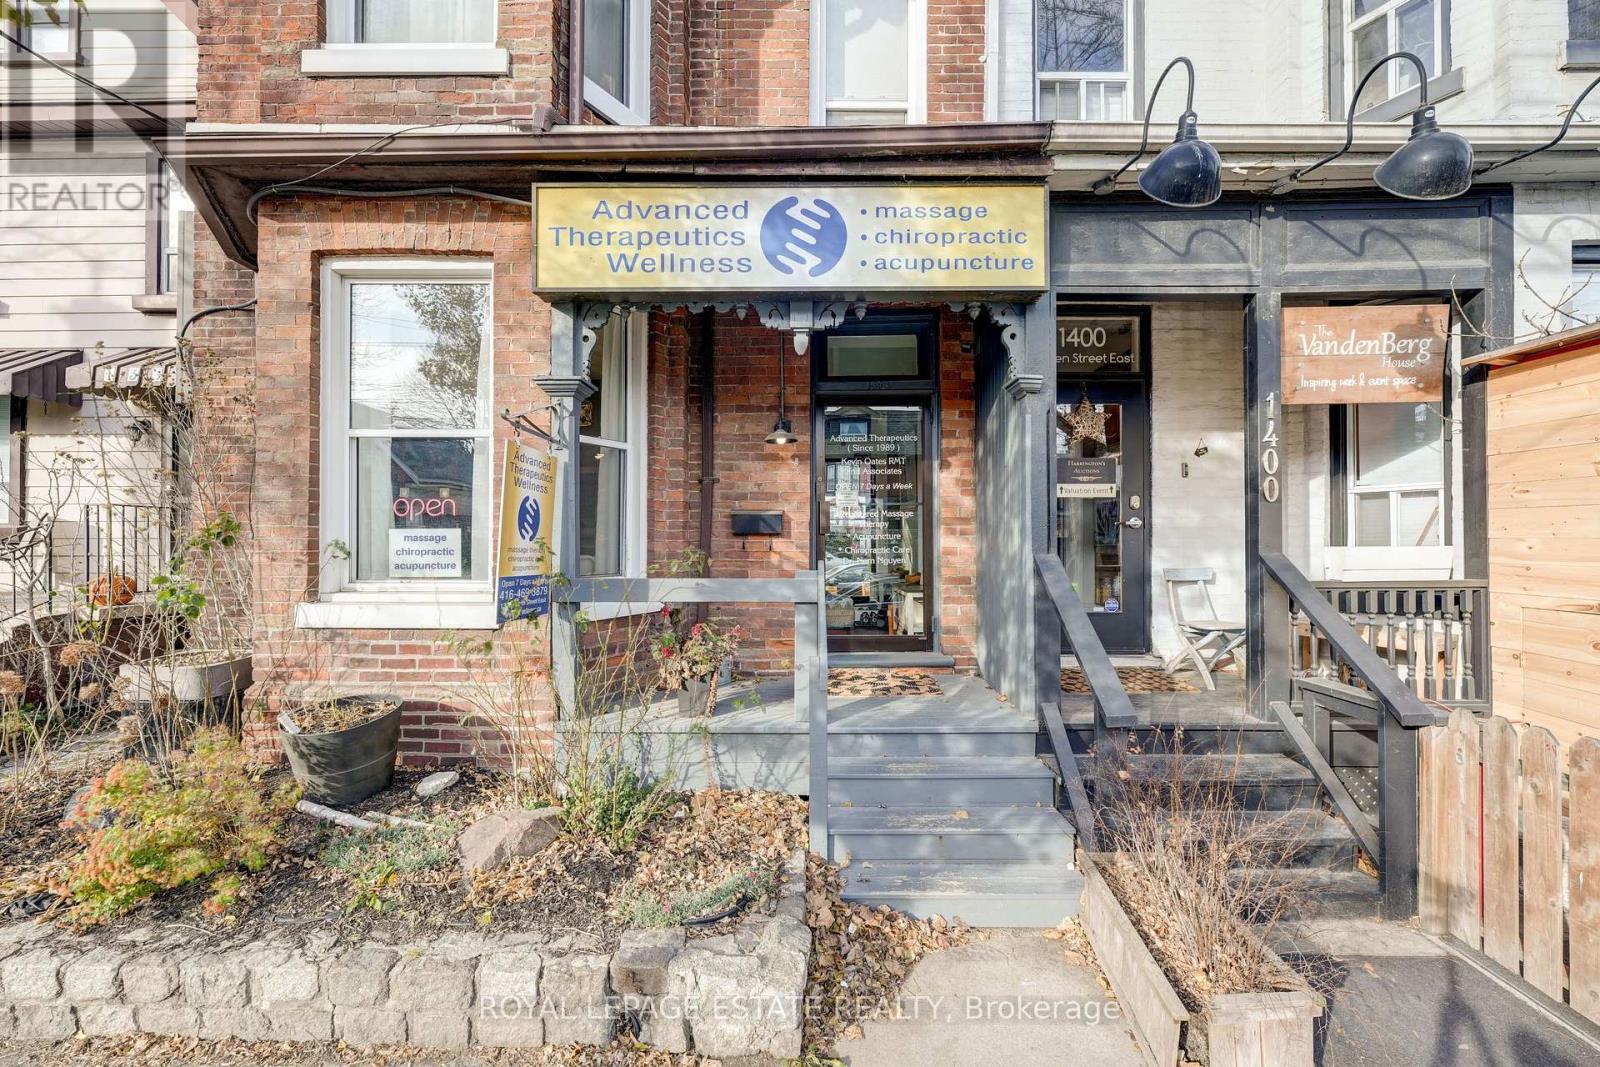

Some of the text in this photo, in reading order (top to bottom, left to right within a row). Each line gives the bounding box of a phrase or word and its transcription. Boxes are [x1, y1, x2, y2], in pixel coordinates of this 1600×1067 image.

[592, 200, 749, 220] Advanced
[875, 206, 988, 221] massage
[548, 227, 746, 250] Therapeutics
[875, 229, 1028, 247] chiropractic
[607, 253, 753, 273] Wellness
[874, 255, 1035, 273] acupuncture
[1058, 327, 1106, 348] 1400
[1312, 324, 1333, 337] The
[1298, 329, 1433, 362] VandenBerg
[1072, 353, 1108, 364] Street
[1109, 353, 1135, 364] East
[1382, 356, 1416, 368] House
[1300, 375, 1338, 392] Inspiring
[830, 433, 918, 443] Advanced Therapeutics
[1262, 392, 1279, 502] 1400
[513, 451, 552, 471] Advanced
[841, 457, 906, 466] Kevin Oates RMT
[509, 462, 553, 484] Therapeutics
[862, 467, 903, 475] Associates
[513, 476, 549, 494] Wellness
[865, 482, 885, 492] Days
[892, 482, 914, 490] Week
[393, 498, 456, 521] open
[880, 510, 915, 518] Massage
[403, 535, 447, 543] massage
[853, 533, 902, 541] Acupuncture
[395, 547, 455, 557] chiropractic
[844, 546, 891, 556] Chiropractic
[394, 562, 457, 571] acupuncture
